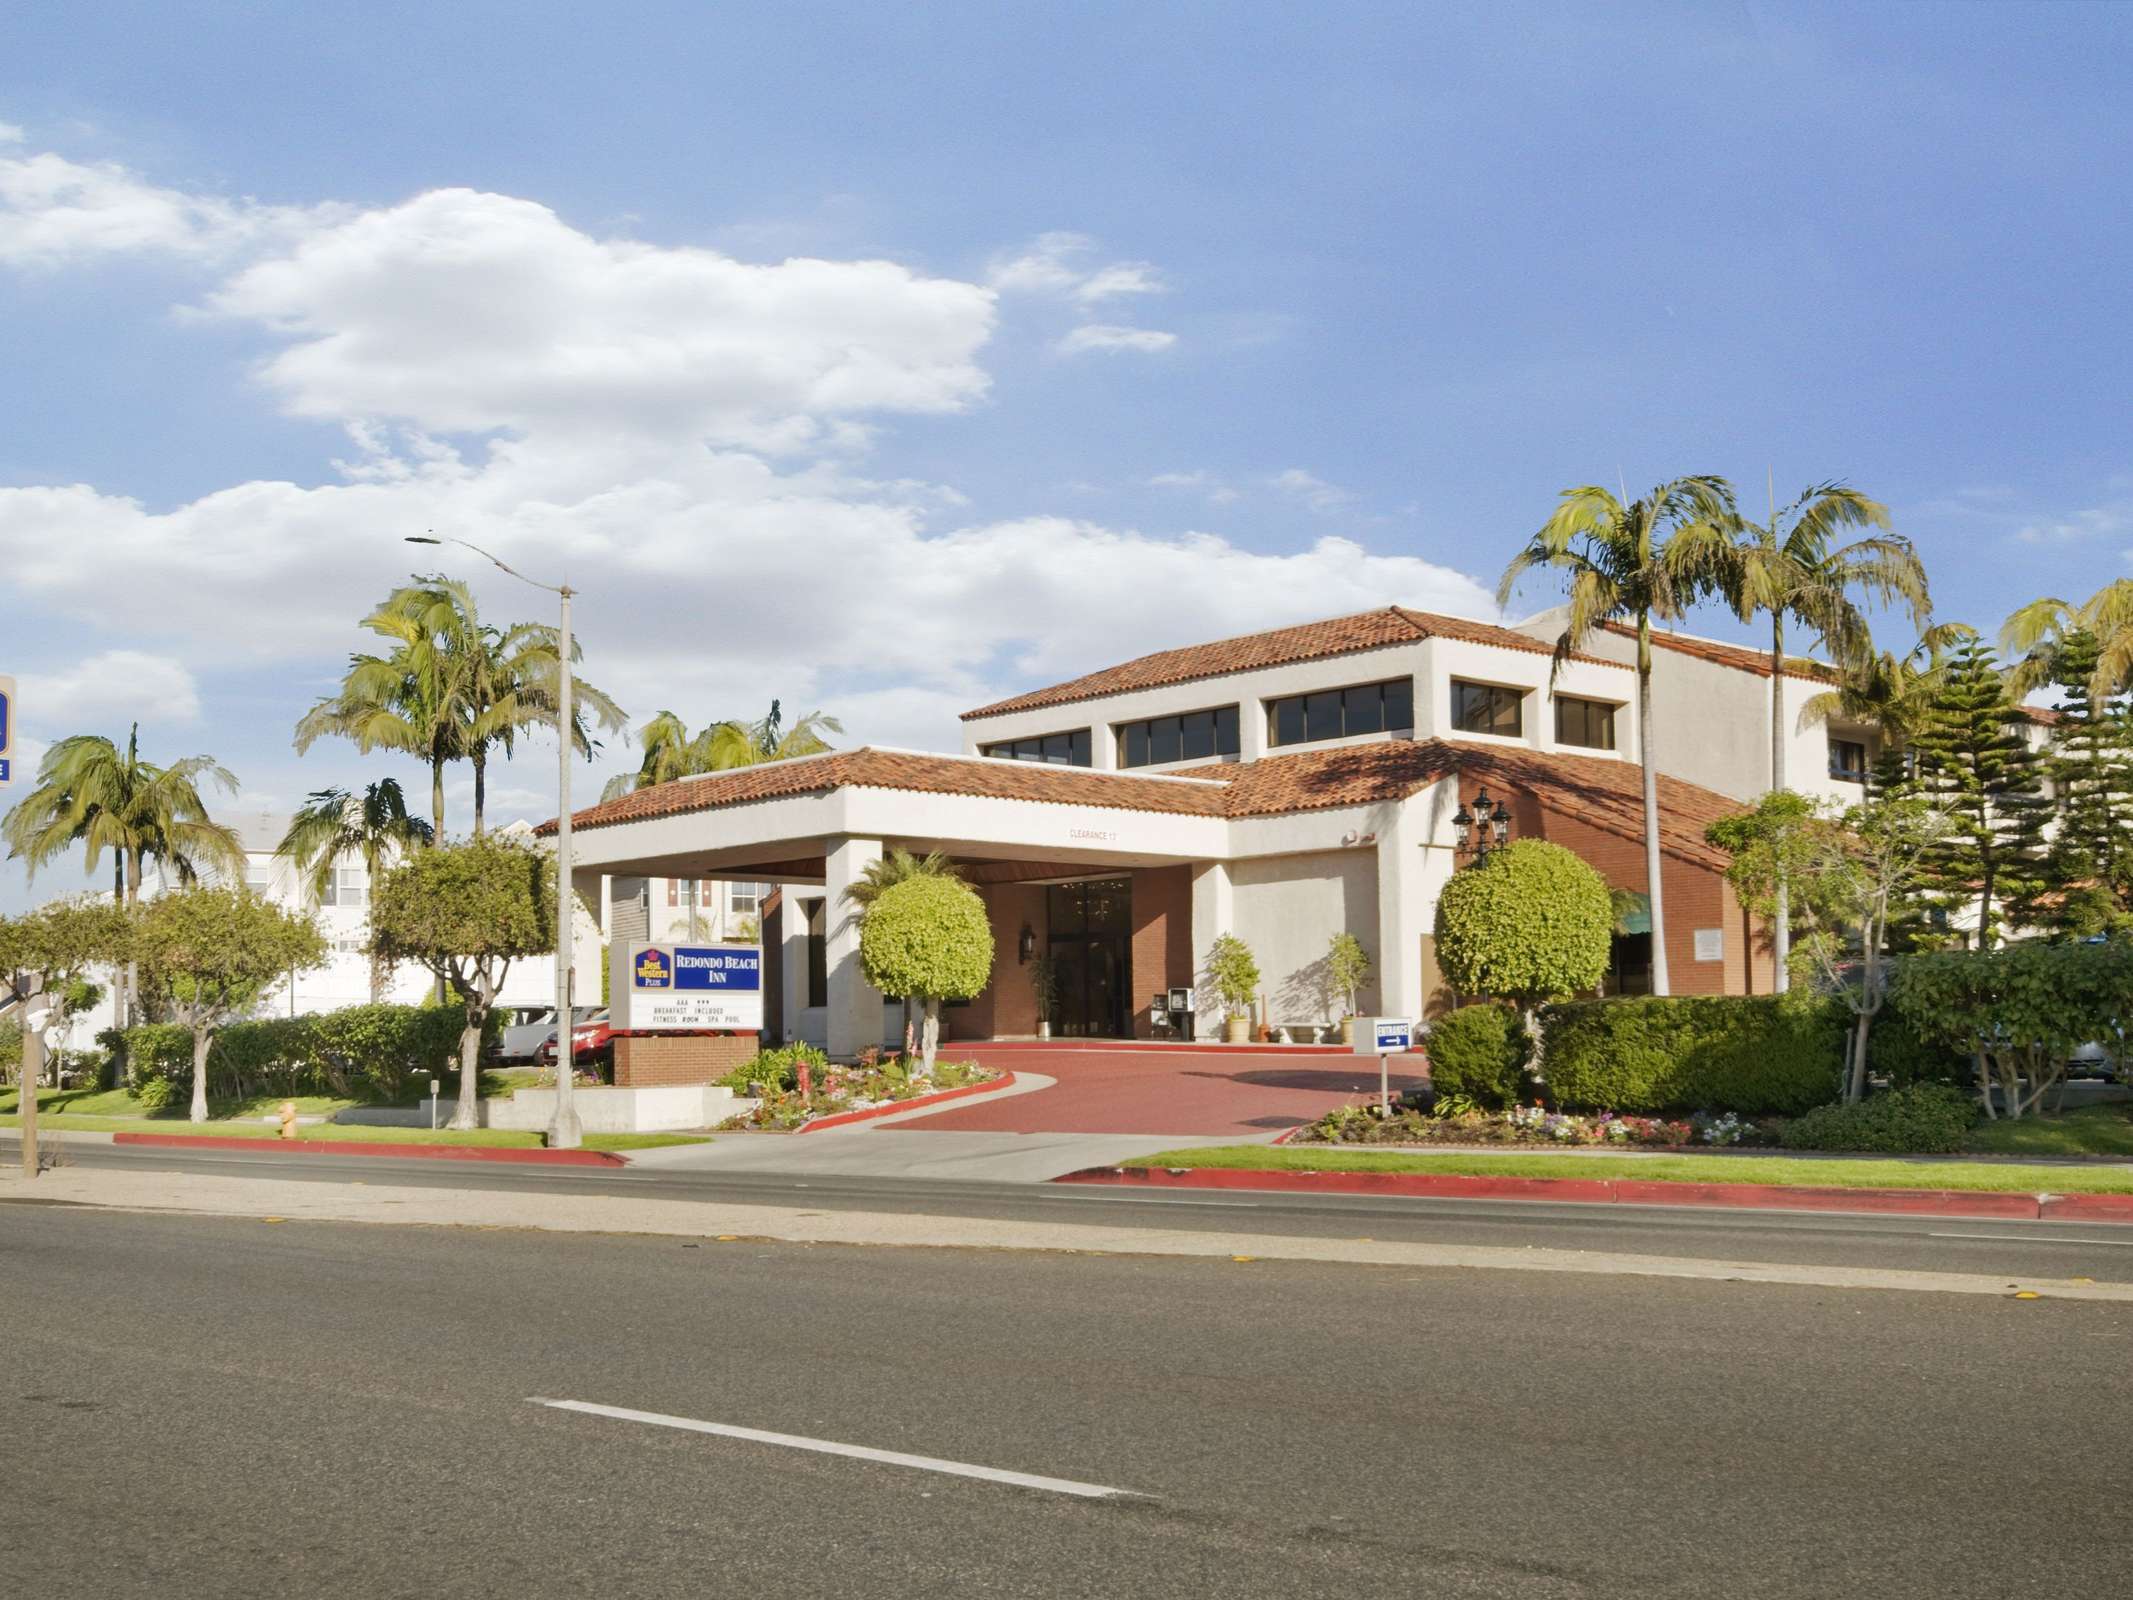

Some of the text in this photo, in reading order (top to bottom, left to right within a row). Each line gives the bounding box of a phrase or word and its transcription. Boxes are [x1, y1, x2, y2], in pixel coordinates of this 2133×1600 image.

[644, 960, 661, 969] Best
[676, 955, 757, 970] REDONDO BEACH
[637, 968, 668, 978] Western
[709, 970, 727, 983] INN
[653, 1007, 724, 1015] BREAKFAST INCLUDED
[653, 1016, 677, 1024] FITNESS
[725, 1016, 741, 1024] POOL
